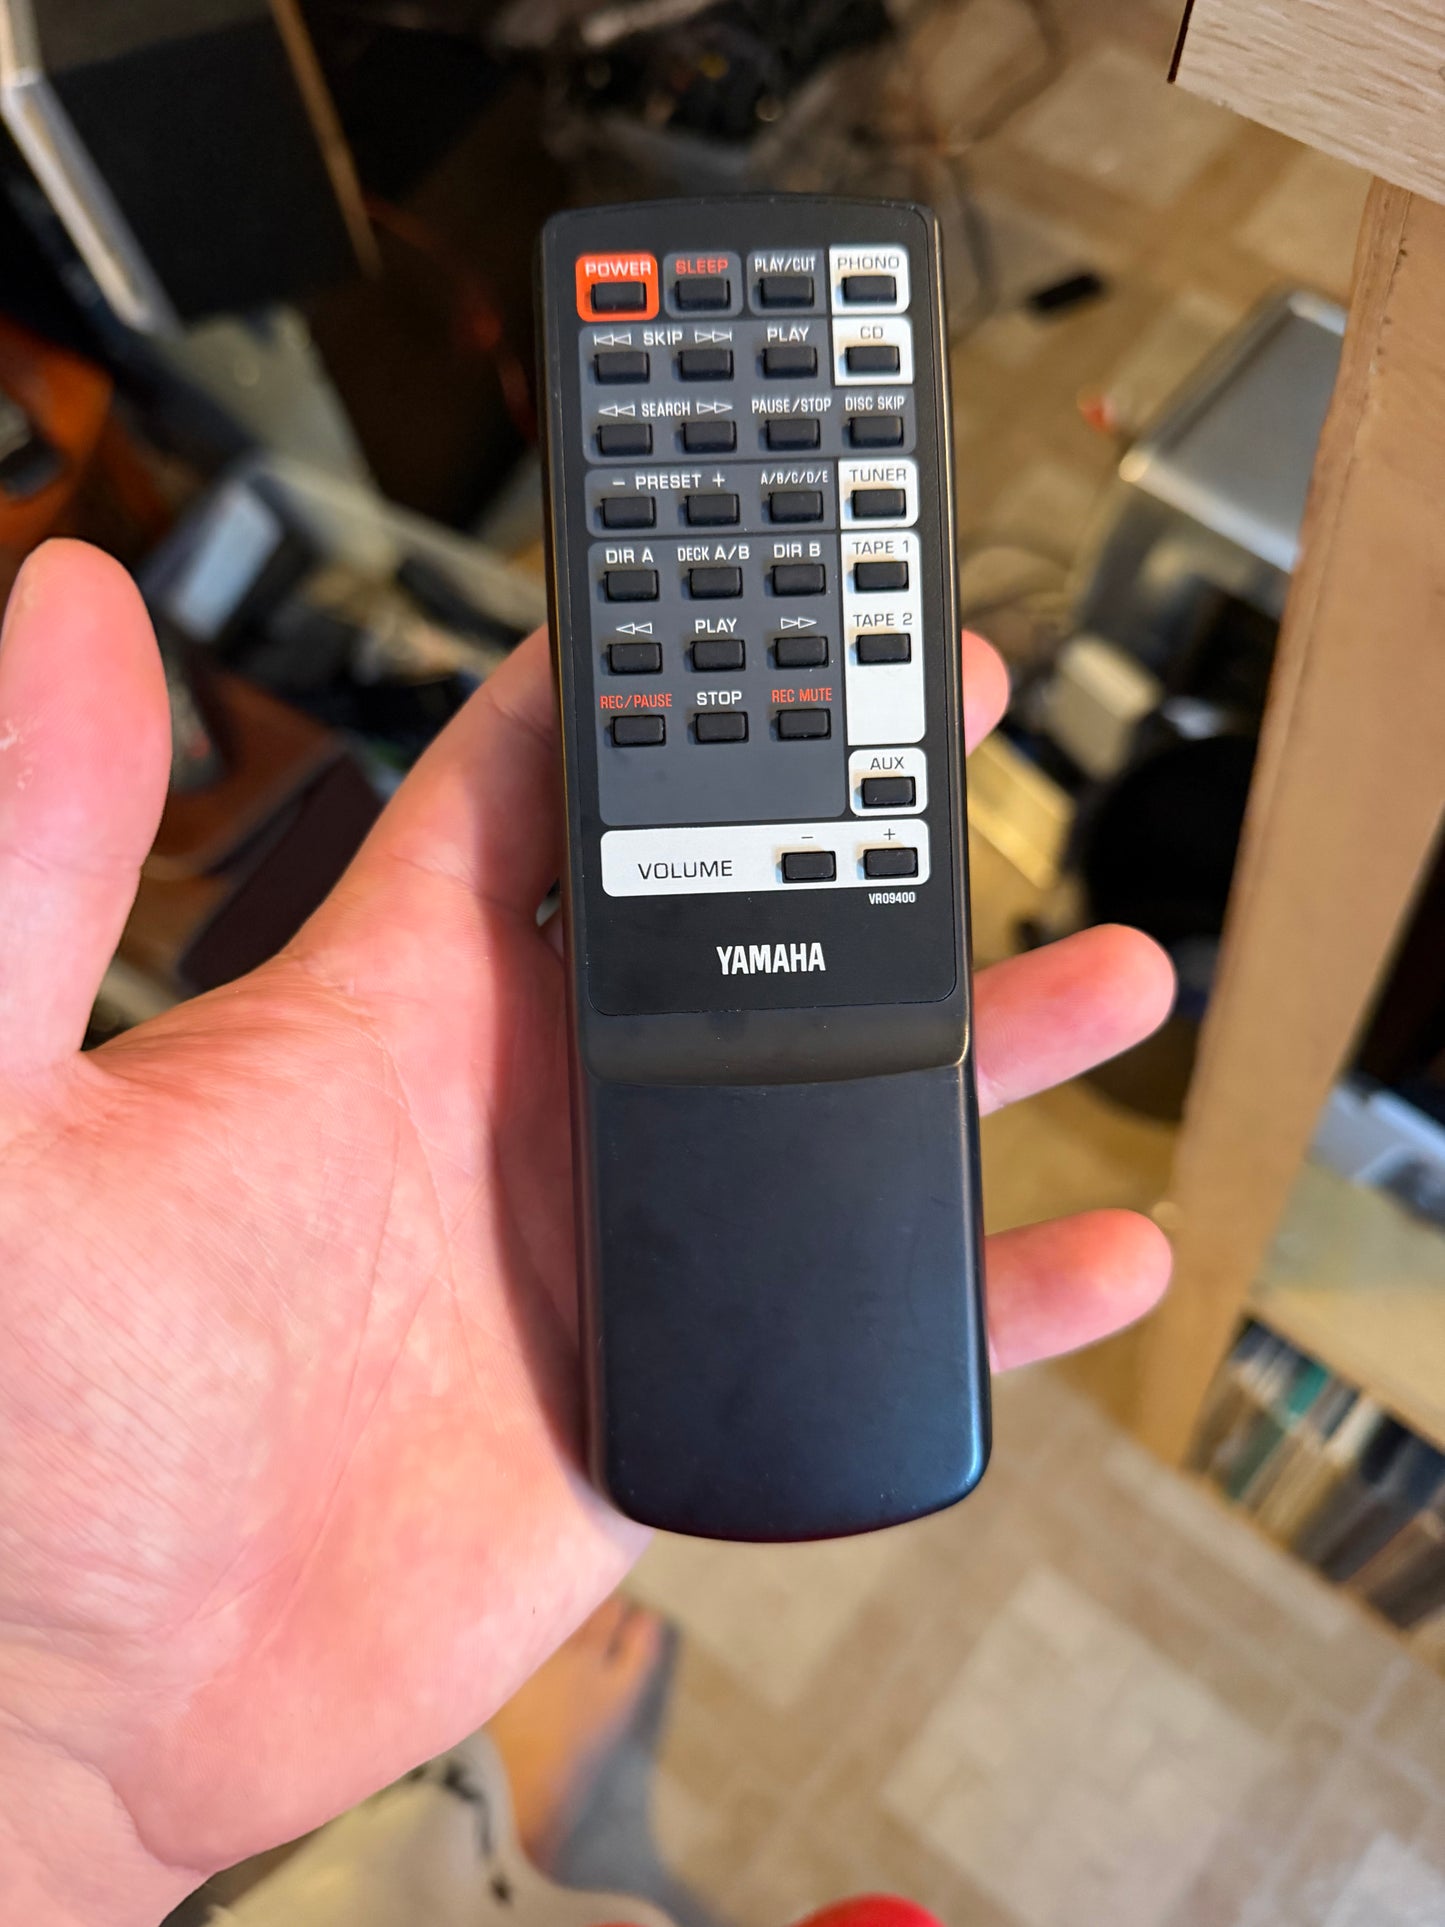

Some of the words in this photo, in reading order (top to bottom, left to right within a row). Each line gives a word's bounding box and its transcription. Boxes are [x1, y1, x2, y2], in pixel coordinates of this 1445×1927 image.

[585, 261, 652, 277] POWER
[675, 259, 728, 275] SLEEP
[754, 257, 816, 273] PLAY/CUT
[837, 256, 899, 271] PHONO
[643, 330, 683, 346] SKIP
[767, 327, 809, 342] PLAY
[860, 326, 884, 340] CD
[642, 402, 690, 417] SEARCH
[752, 398, 831, 414] PAUSE/STOP
[845, 396, 874, 411] DISC
[878, 395, 905, 410] SKIP
[635, 473, 701, 490] PRESET
[760, 470, 828, 486] A/B/C/D/E
[849, 467, 907, 483] TUNER
[677, 547, 709, 562] DECK
[714, 545, 750, 560] A/B
[773, 544, 802, 558] DIR
[809, 543, 821, 557] B
[852, 541, 895, 555] TAPE
[902, 541, 910, 554] 1
[606, 549, 635, 564] DIR
[641, 549, 654, 563] A
[695, 618, 737, 634] PLAY
[853, 612, 895, 627] TAPE
[902, 612, 913, 625] 2
[600, 693, 673, 710] REC/PAUSE
[696, 690, 743, 706] STOP
[771, 688, 795, 703] REC
[799, 687, 832, 702] MUTE
[870, 756, 905, 770] AUX
[637, 859, 734, 880] VOLUME
[716, 942, 826, 976] YAMAHA
